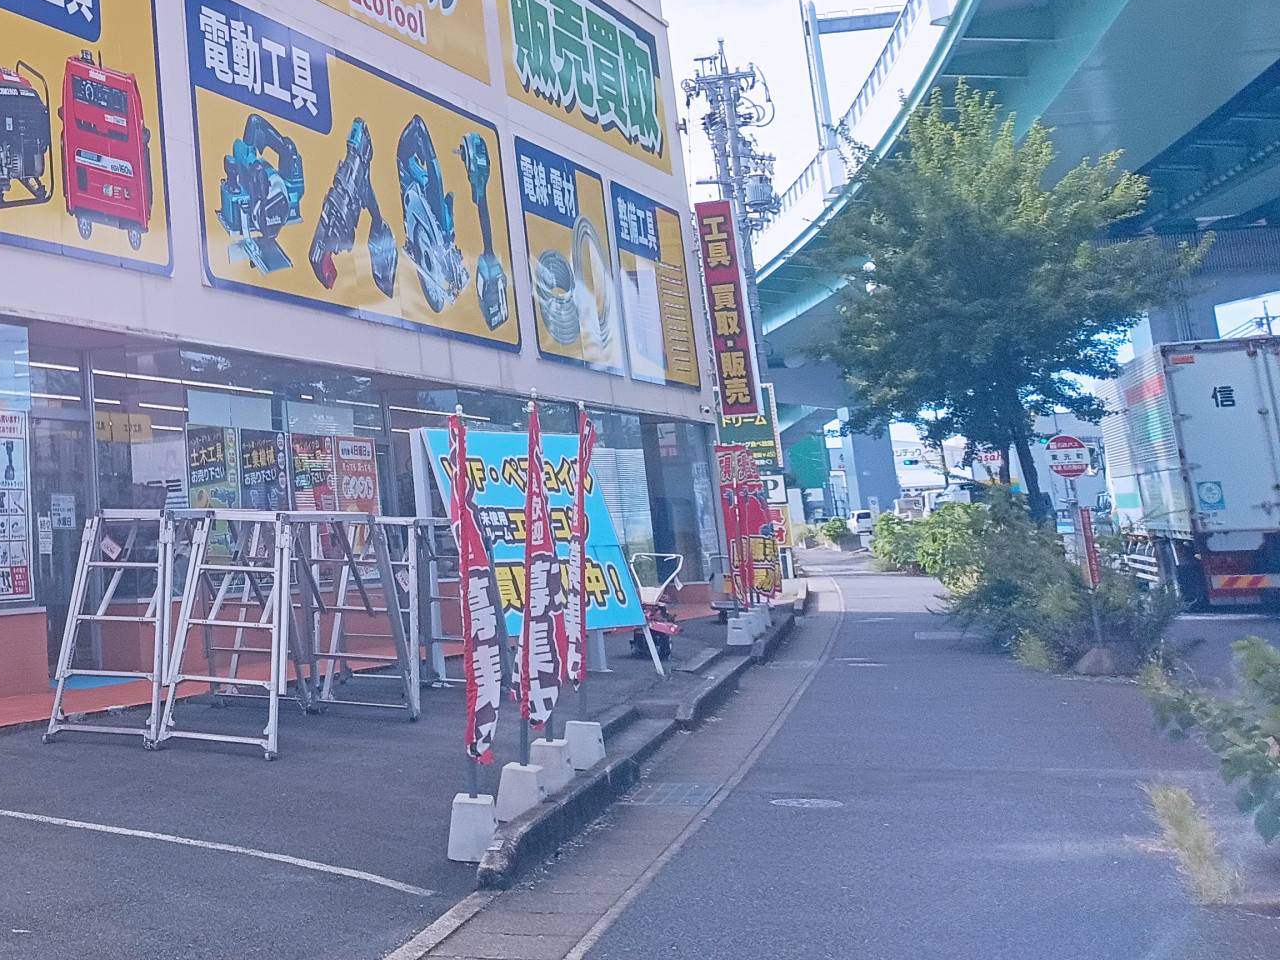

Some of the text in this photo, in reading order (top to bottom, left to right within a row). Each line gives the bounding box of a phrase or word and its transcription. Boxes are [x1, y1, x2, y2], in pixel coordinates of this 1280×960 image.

[199, 6, 319, 117] 電動工具
[520, 154, 576, 218] 電線・電材
[617, 196, 658, 252] 整備工具
[703, 216, 751, 406] 工具 買取・販売
[1211, 386, 1236, 408] 信
[190, 442, 224, 467] 土木工具
[191, 466, 226, 483] お売り下さい
[244, 468, 277, 486] お売り下さい
